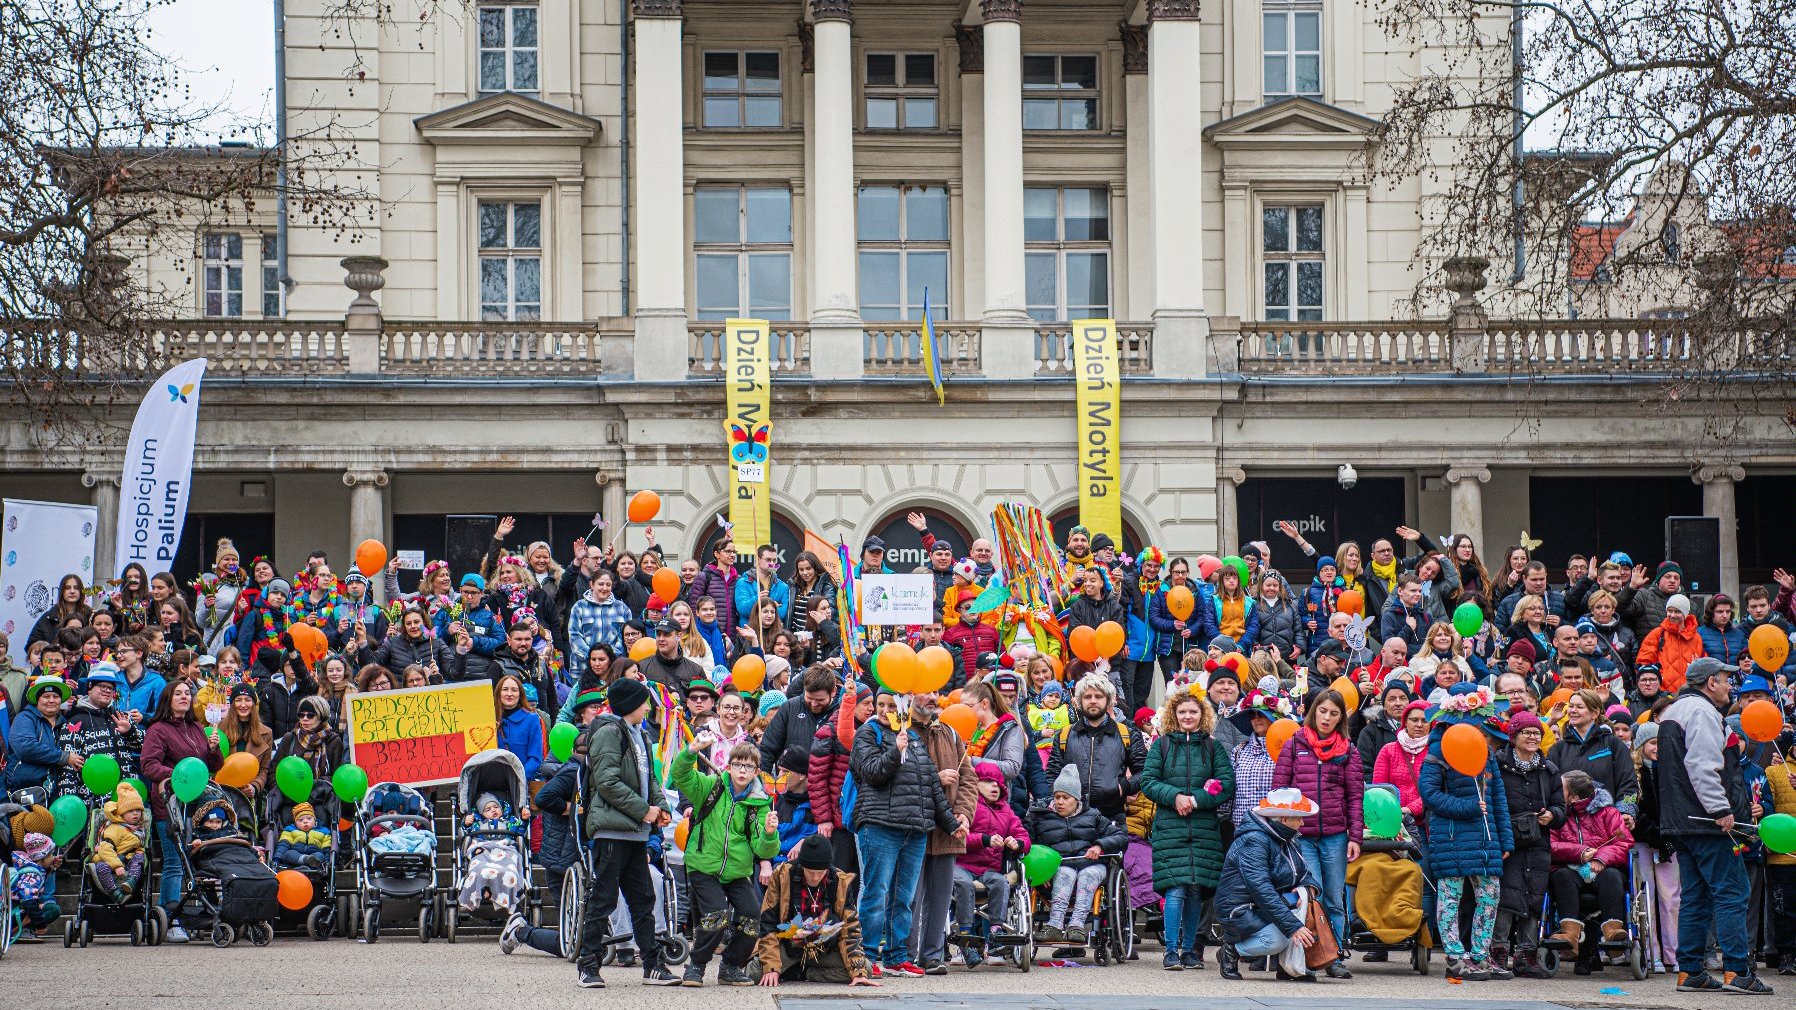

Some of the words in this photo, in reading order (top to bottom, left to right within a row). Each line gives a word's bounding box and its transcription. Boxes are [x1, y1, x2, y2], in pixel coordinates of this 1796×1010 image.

[737, 329, 763, 392] Dzień
[1083, 326, 1113, 391] Dzień
[1083, 401, 1114, 498] Motyla
[130, 438, 157, 560] Hospicjum
[156, 480, 180, 561] Palium
